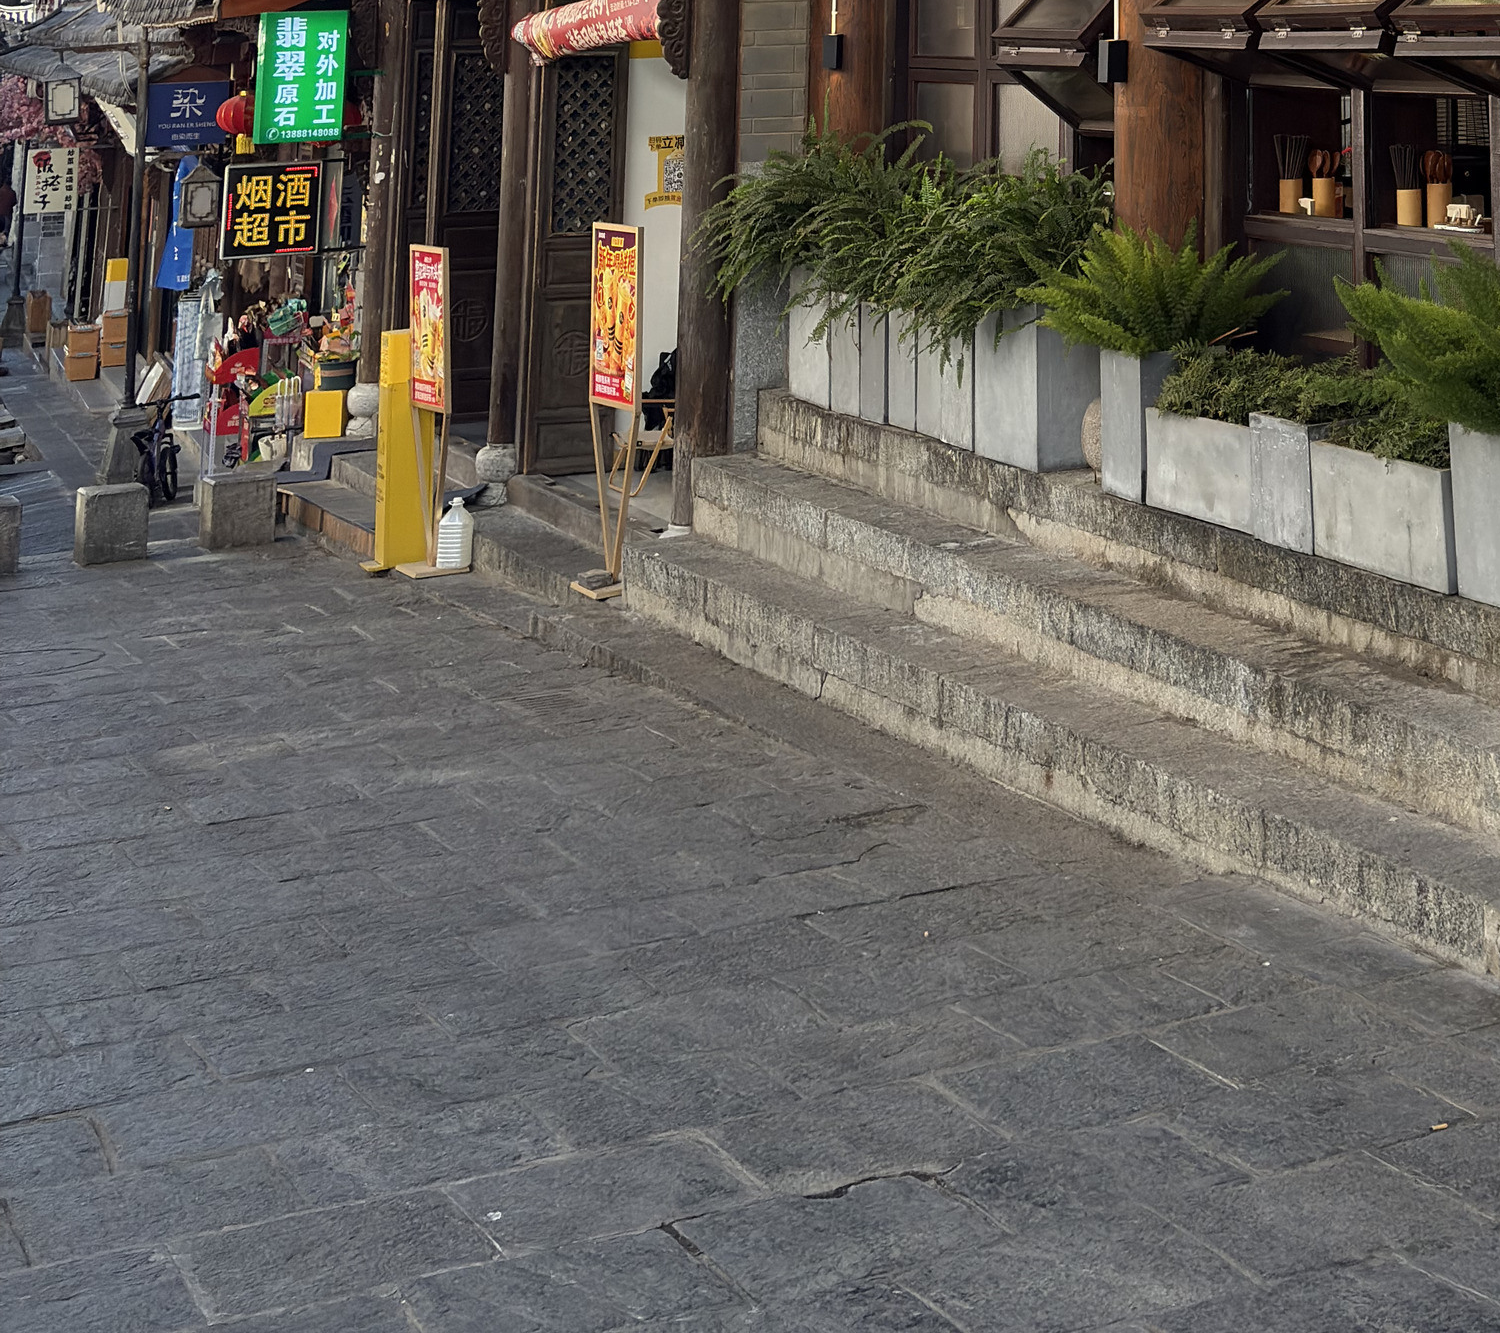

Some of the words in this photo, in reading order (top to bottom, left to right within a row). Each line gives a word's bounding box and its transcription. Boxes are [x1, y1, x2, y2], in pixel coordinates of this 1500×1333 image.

[273, 17, 308, 127] 翡翠原石
[312, 30, 341, 124] 对外加工
[170, 88, 206, 118] 染
[281, 128, 339, 138] 13888148088
[235, 174, 312, 210] 烟酒
[232, 209, 311, 247] 超市
